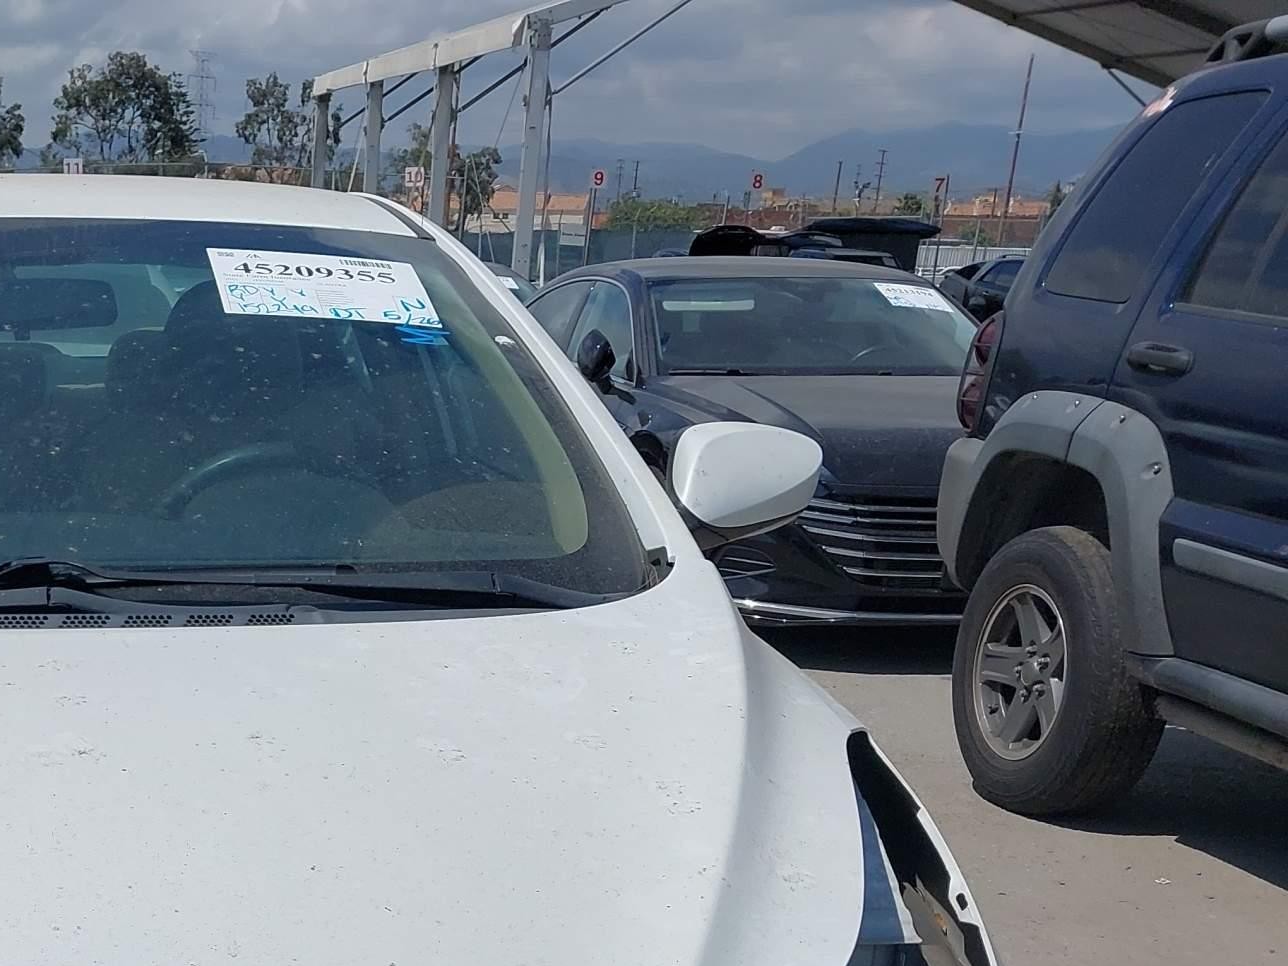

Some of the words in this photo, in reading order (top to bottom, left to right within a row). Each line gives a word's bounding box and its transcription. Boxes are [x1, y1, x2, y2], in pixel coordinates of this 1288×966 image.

[406, 170, 422, 183] 10
[594, 172, 604, 186] 9
[752, 174, 763, 189] 8
[935, 177, 946, 193] 7
[234, 262, 396, 284] 45209355
[400, 298, 426, 312] N
